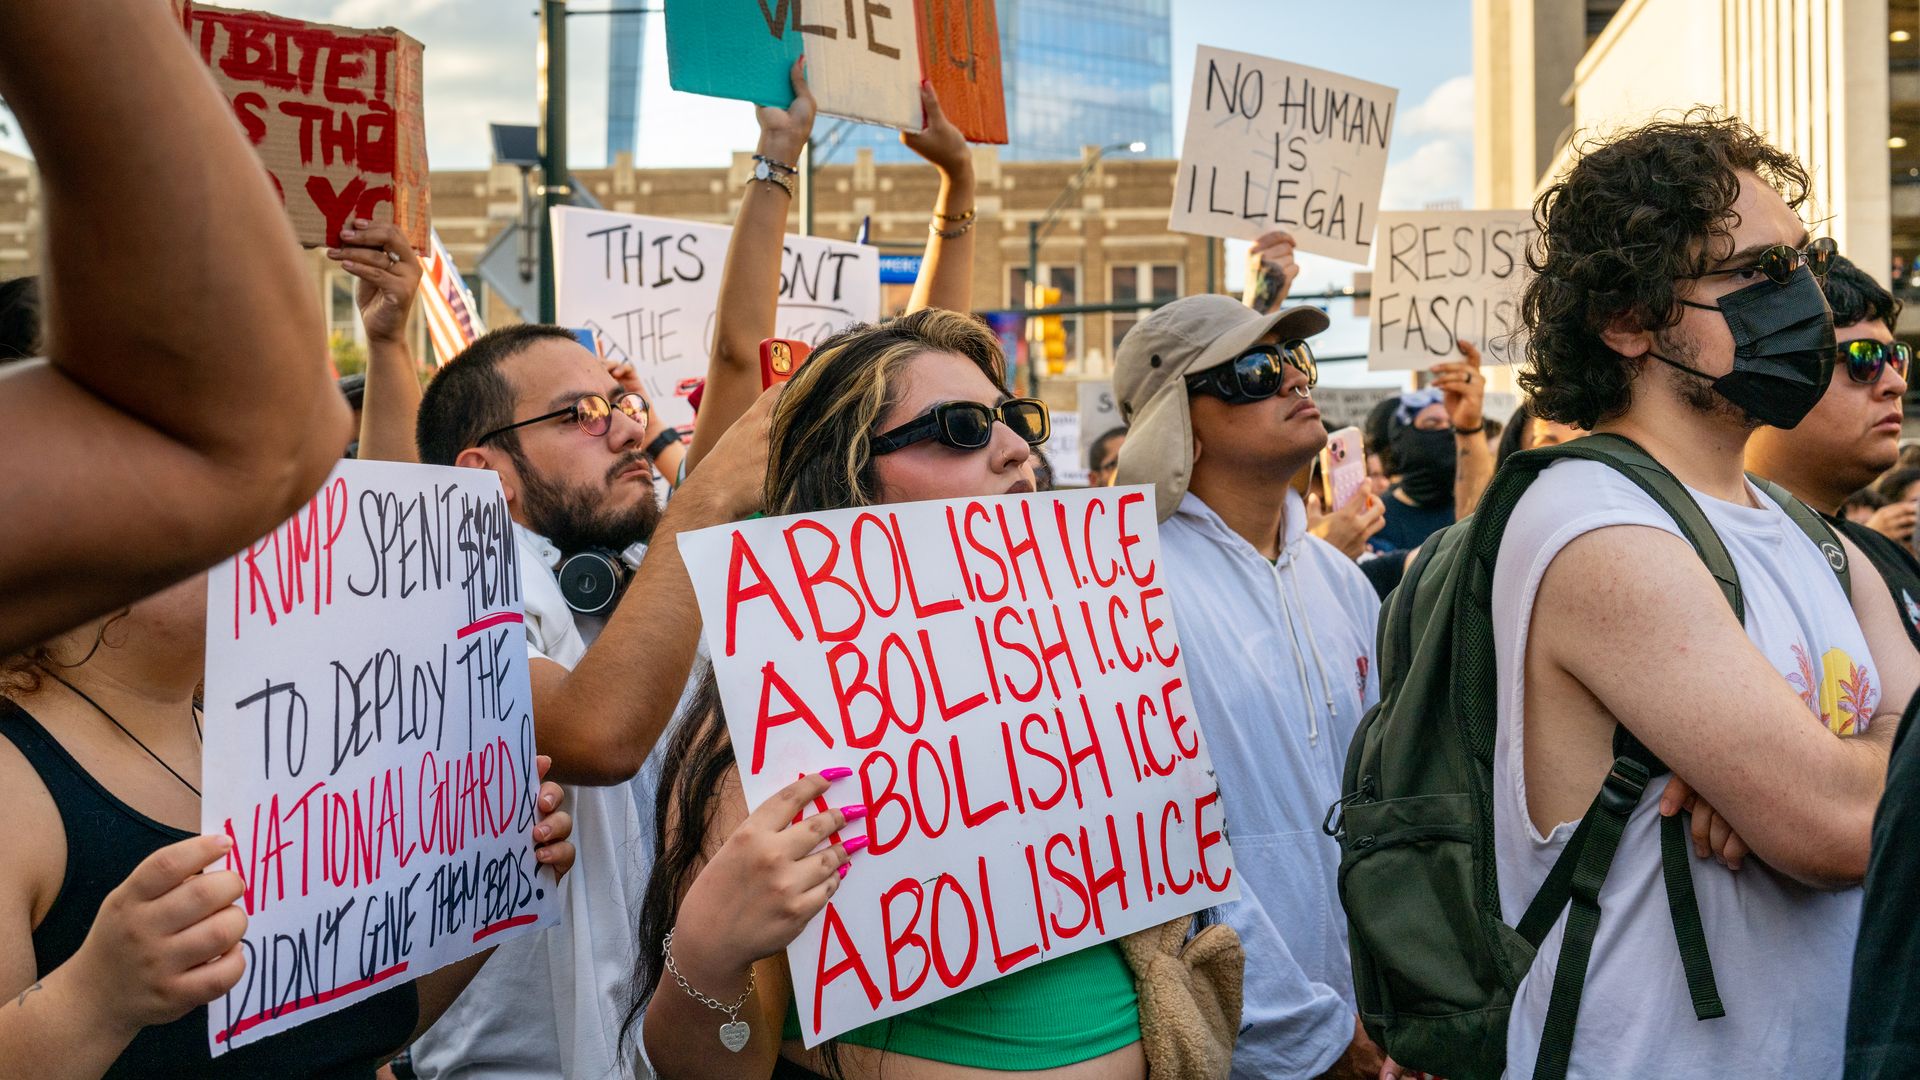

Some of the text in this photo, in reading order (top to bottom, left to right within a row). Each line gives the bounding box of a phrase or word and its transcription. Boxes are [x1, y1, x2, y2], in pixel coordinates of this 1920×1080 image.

[1205, 58, 1392, 149] NO HUMAN
[1274, 132, 1307, 171] IS
[587, 223, 704, 289] THIS
[1187, 165, 1371, 247] ILLEGAL
[611, 306, 682, 366] THE
[348, 483, 458, 599] SPENT
[725, 498, 1054, 658] ABOLISH
[235, 628, 515, 780] TO DEPLOY THE
[751, 603, 1081, 776] ABOLISH
[223, 765, 417, 916] NATIONAL
[418, 735, 518, 857] GUARD
[225, 895, 356, 1050] DIDN'T
[359, 872, 421, 983] GIVE
[425, 850, 480, 948] THEM
[812, 813, 1130, 1036] ABOLISH
